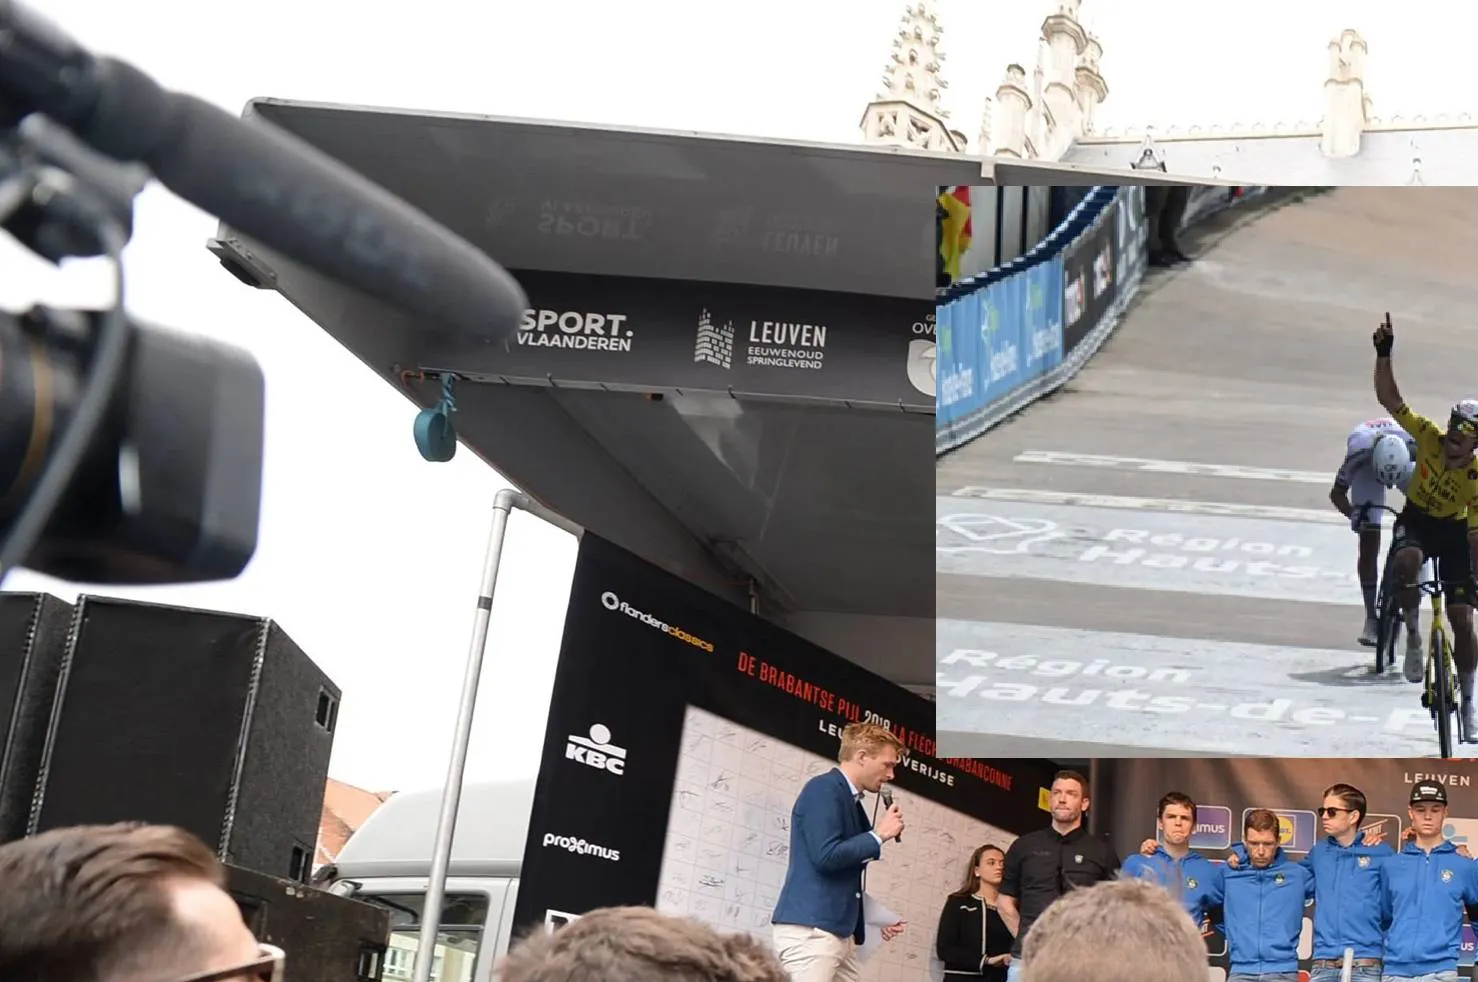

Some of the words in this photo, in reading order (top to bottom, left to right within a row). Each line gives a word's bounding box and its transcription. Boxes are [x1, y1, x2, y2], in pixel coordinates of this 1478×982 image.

[516, 331, 632, 352] VLAANDEREN
[749, 320, 827, 348] LEUVEN
[746, 355, 823, 370] SPRINGLEVEND
[747, 346, 824, 360] EEUWENOUD
[1103, 528, 1313, 558] Région
[620, 601, 715, 653] flandersclassics
[940, 648, 1192, 684] Région
[738, 651, 756, 676] DE
[759, 661, 836, 712] BRABANTSE
[837, 698, 860, 723] PIJL
[565, 742, 625, 776] KBC
[543, 832, 621, 862] proximus
